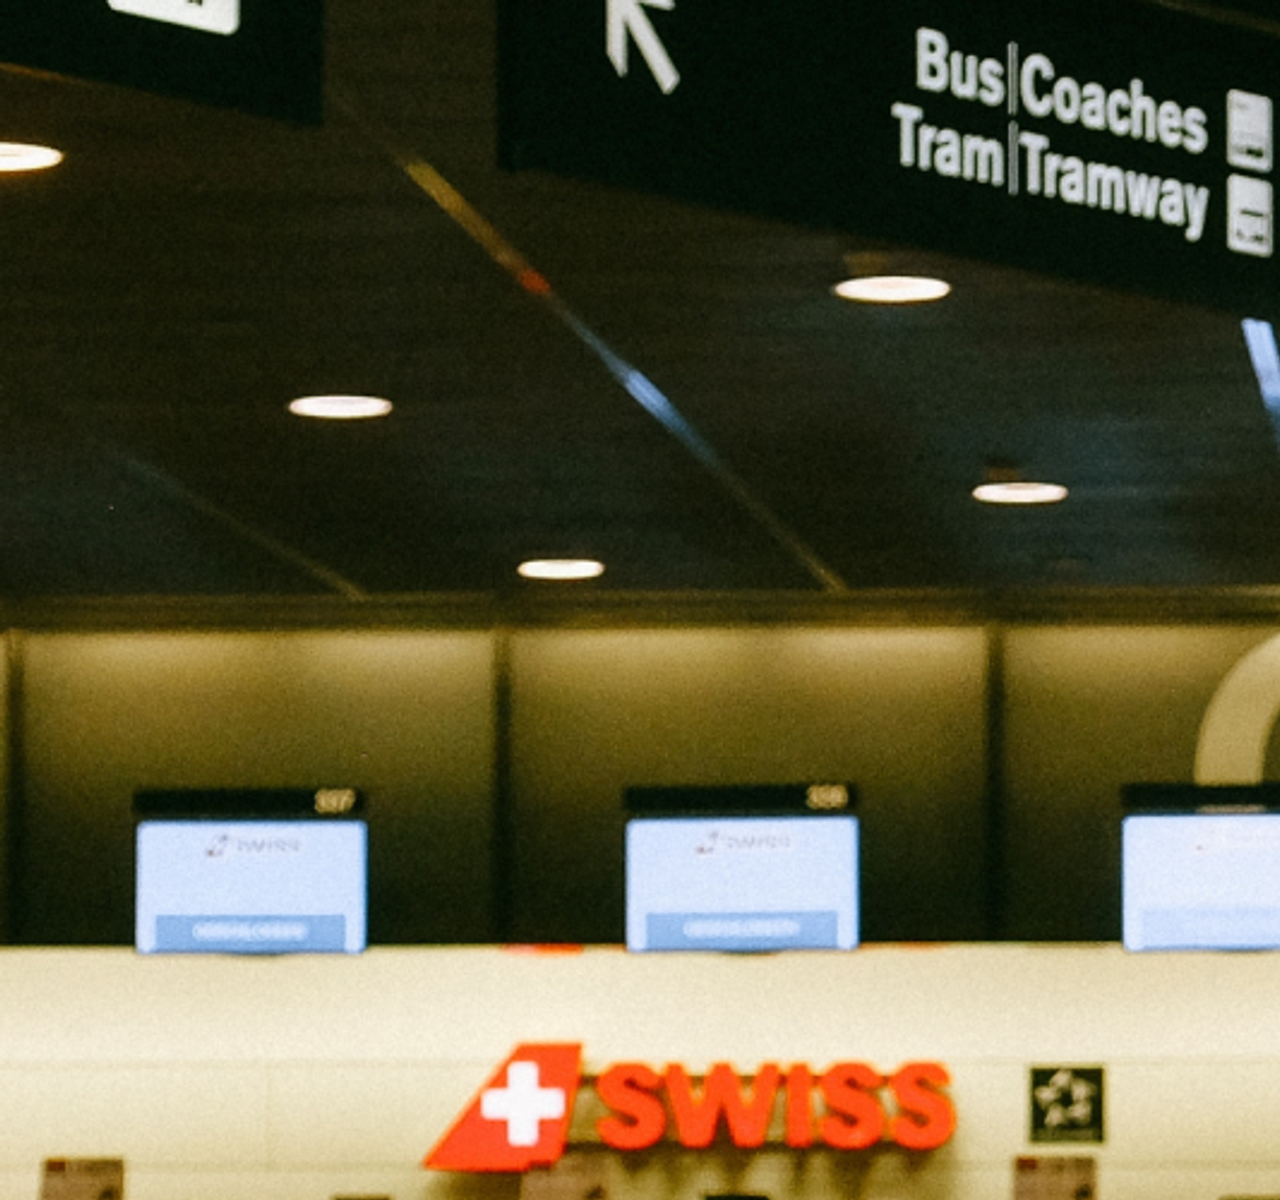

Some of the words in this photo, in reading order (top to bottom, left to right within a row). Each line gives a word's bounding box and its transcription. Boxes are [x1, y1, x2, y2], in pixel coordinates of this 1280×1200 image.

[914, 26, 1006, 107] Bus
[1020, 53, 1209, 155] Coaches
[890, 102, 1005, 187] Tram
[1017, 130, 1210, 243] Tramway
[595, 1060, 958, 1151] SWISS
